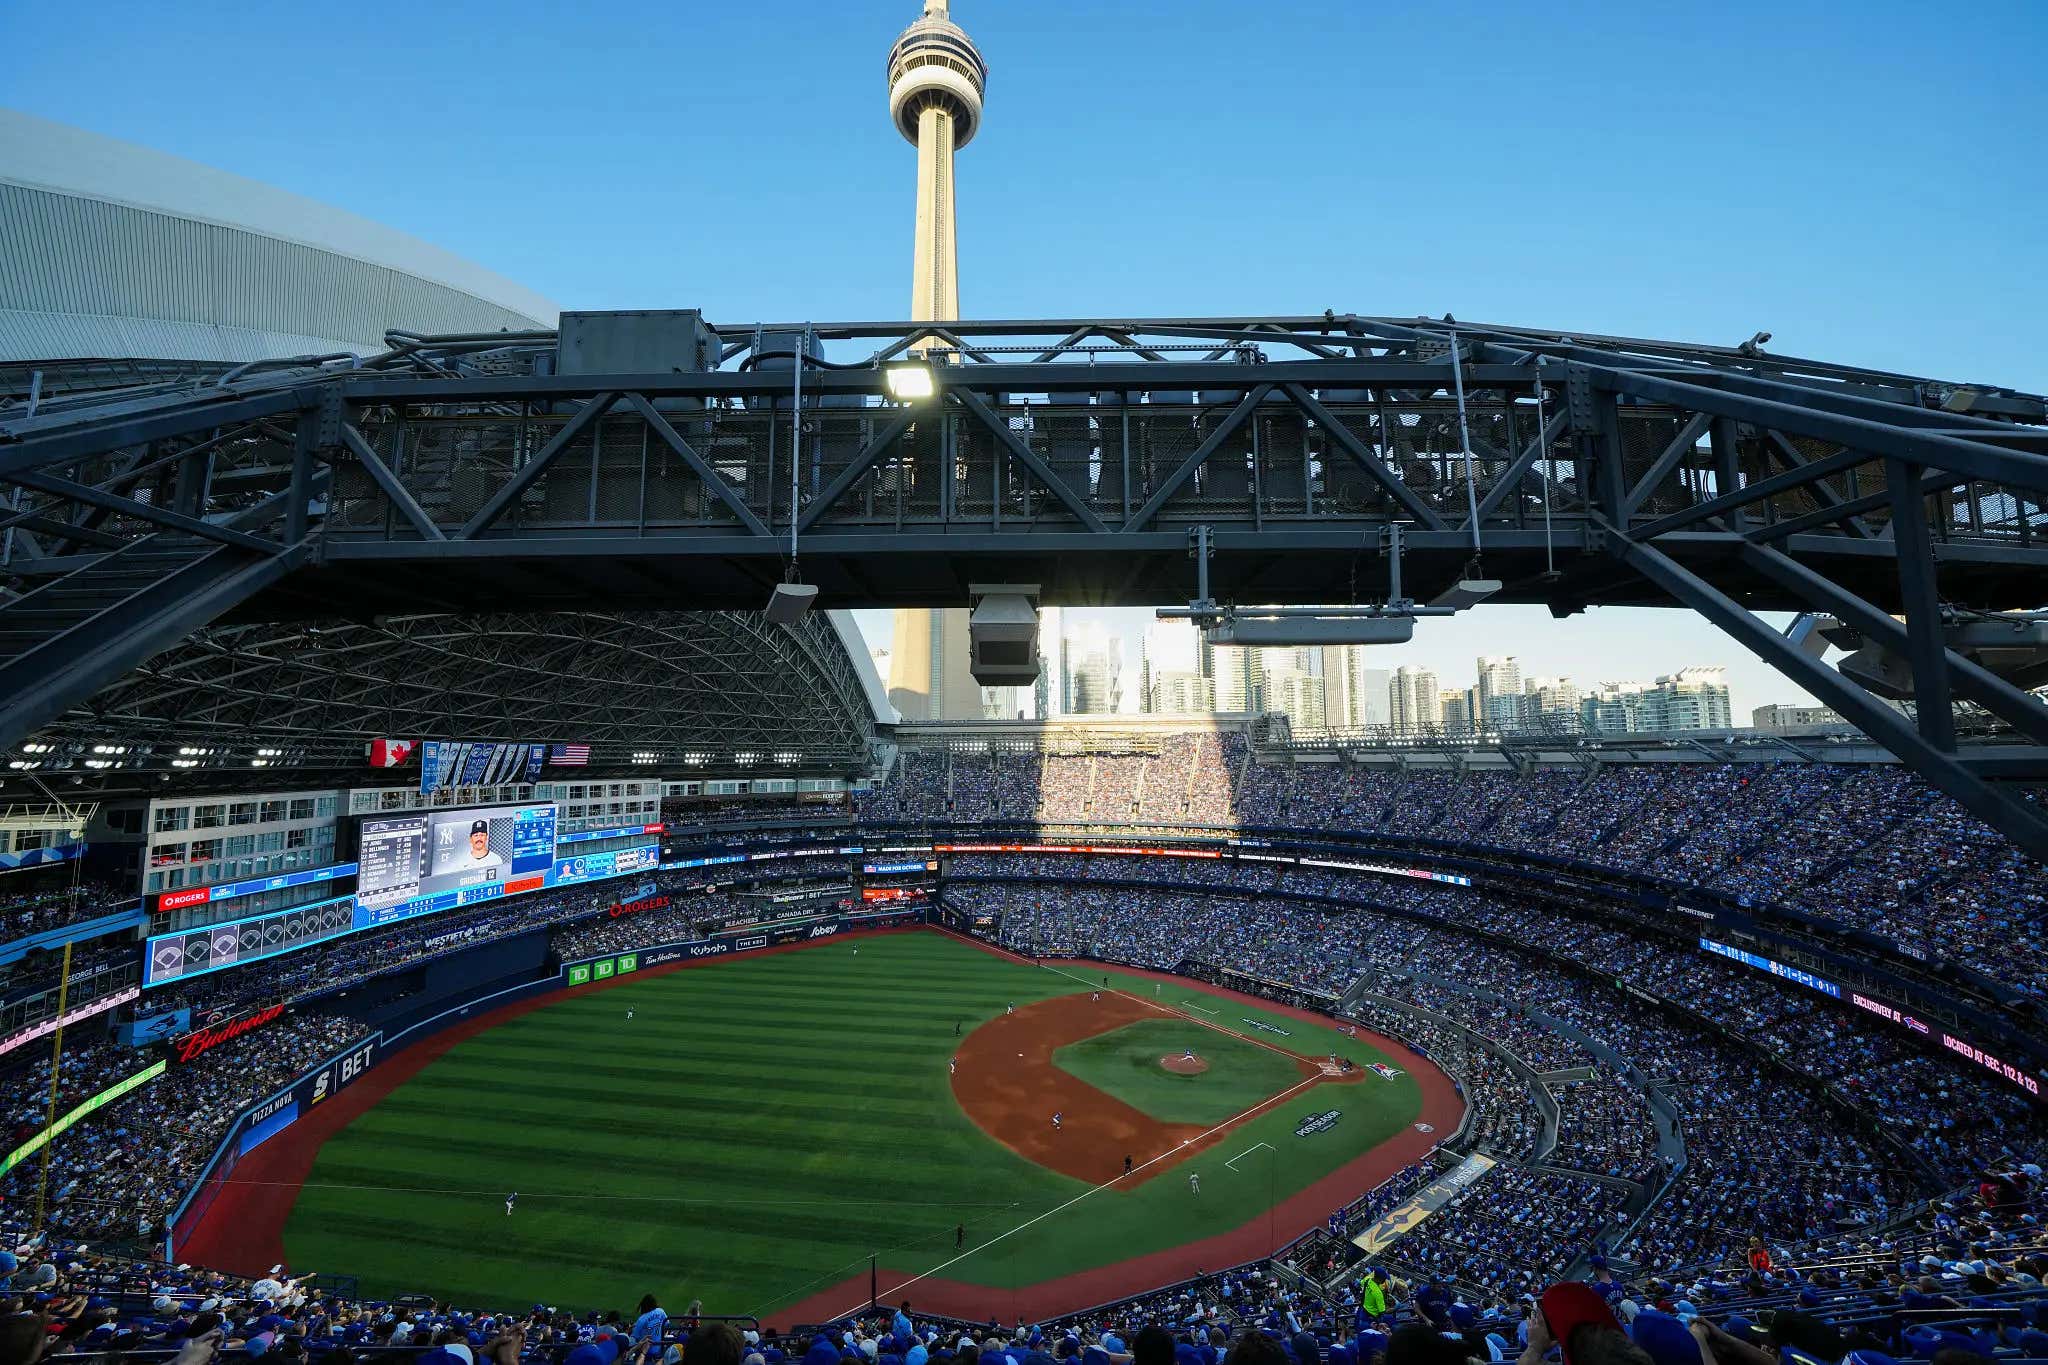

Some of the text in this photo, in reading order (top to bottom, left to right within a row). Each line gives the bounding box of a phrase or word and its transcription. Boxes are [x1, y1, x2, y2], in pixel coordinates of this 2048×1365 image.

[174, 893, 205, 904] ROGERS
[625, 896, 669, 912] ROGERS
[777, 910, 801, 919] CANADA
[1677, 905, 1715, 919] SPORTSNET
[725, 917, 758, 927] BLEACHERS
[425, 931, 464, 947] WESTJET
[691, 944, 727, 955] Kubota
[620, 958, 635, 969] TD
[645, 953, 681, 965] Tim Hortons
[67, 963, 108, 982] GEORGE BELL
[572, 969, 588, 981] TD
[596, 963, 612, 975] TD
[1853, 994, 1900, 1023] EXCLUSIVELY AT
[176, 1003, 285, 1063] Budweiser
[341, 1044, 374, 1082] BET
[1944, 1034, 2038, 1094] LOCATED AT SEC. 112 & 123
[252, 1091, 292, 1125] PIZZA NOVA
[1296, 1110, 1342, 1137] POSTSEASON
